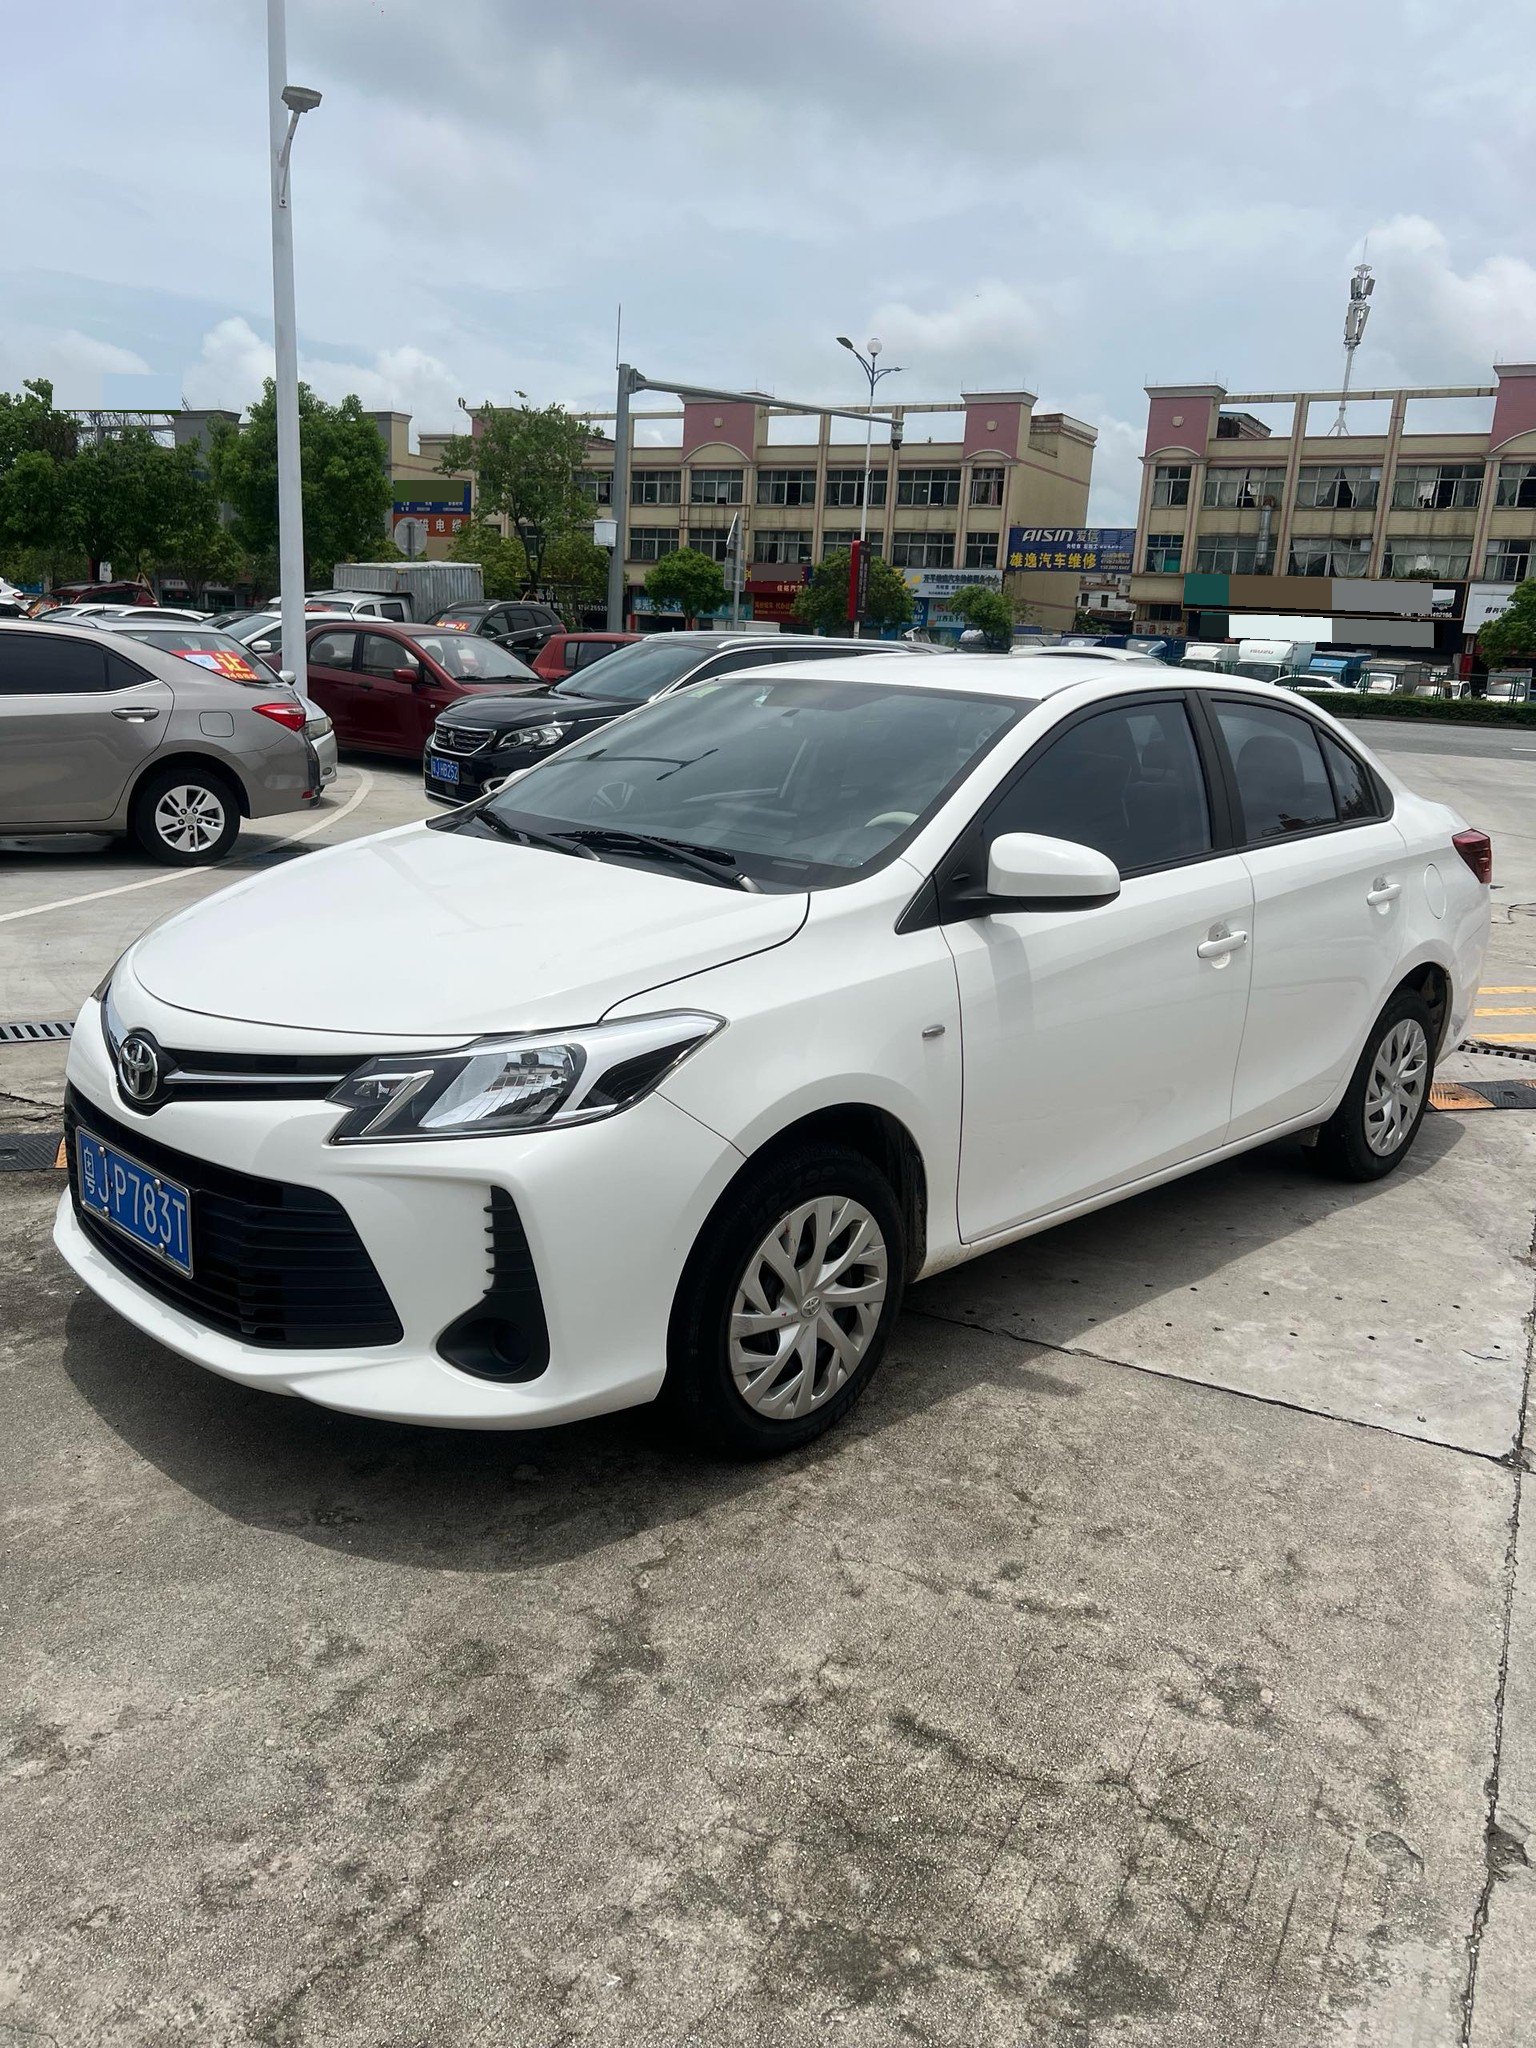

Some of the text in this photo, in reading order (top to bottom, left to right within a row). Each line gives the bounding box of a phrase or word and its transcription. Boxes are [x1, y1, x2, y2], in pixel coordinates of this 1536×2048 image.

[1022, 529, 1073, 542] AISIN
[1009, 552, 1097, 570] 雄逸汽车维修
[215, 652, 250, 672] 让
